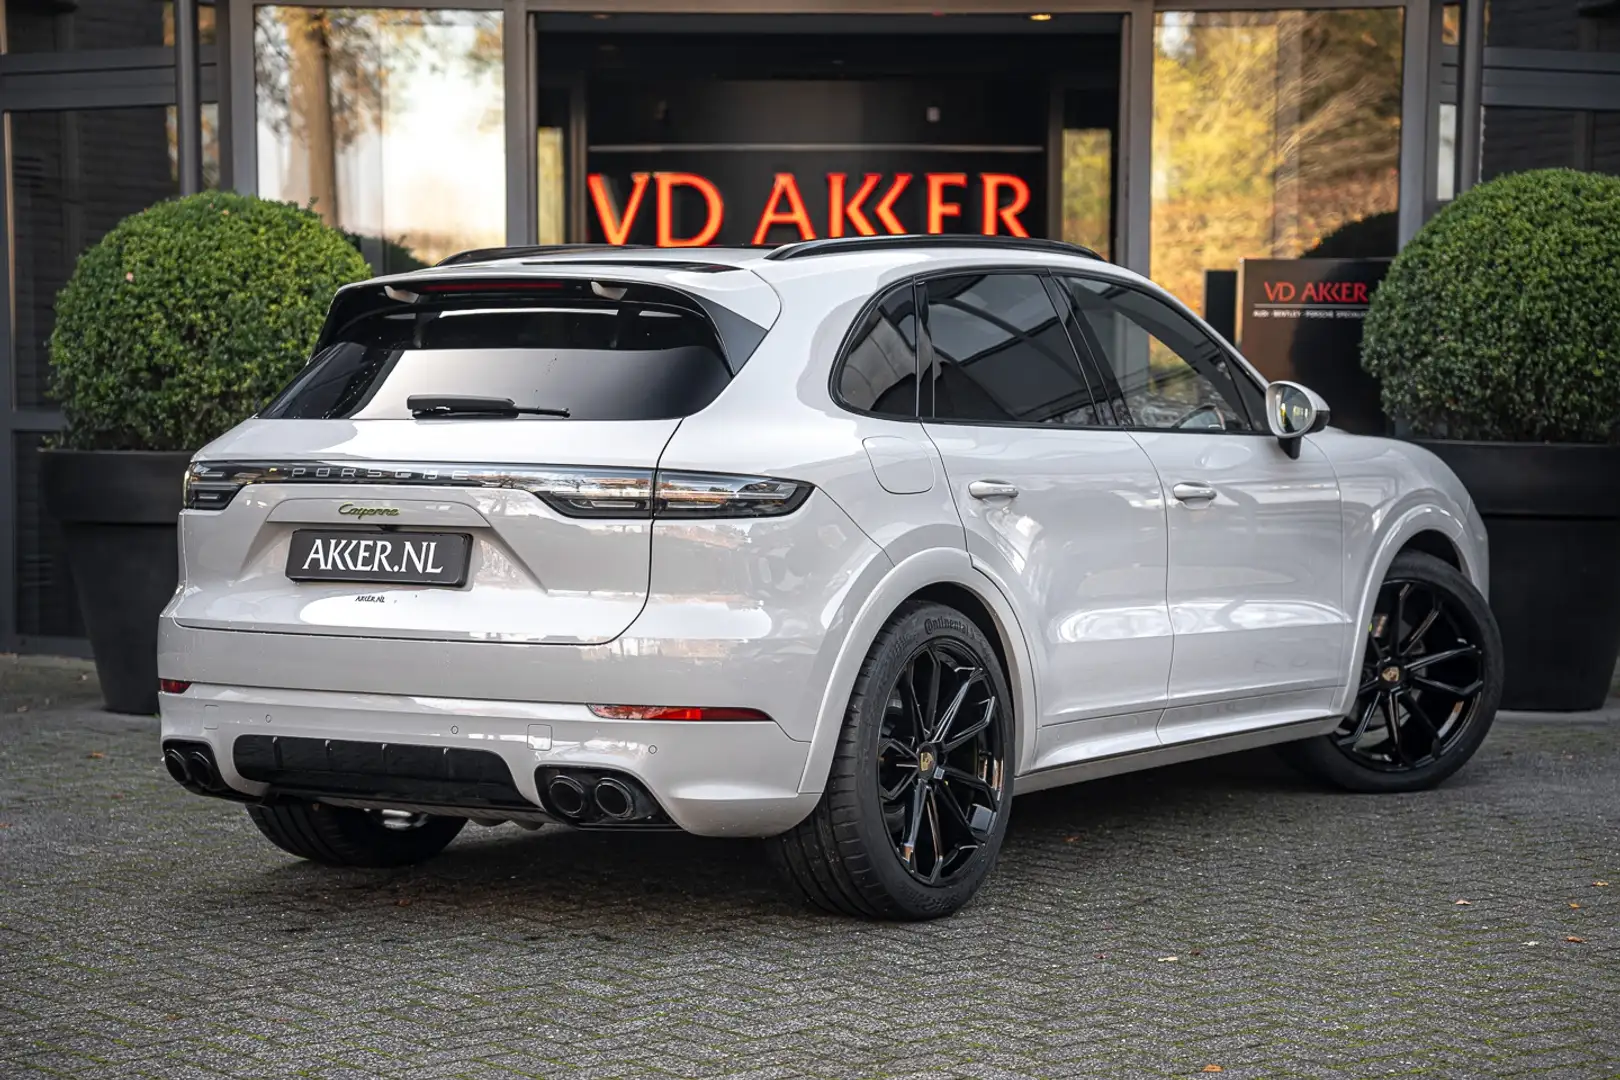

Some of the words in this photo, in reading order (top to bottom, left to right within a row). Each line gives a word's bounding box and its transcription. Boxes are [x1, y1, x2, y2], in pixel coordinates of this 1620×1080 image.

[587, 172, 724, 247] VD
[1263, 281, 1296, 303] VD
[1300, 281, 1369, 303] AKKER
[291, 467, 469, 481] PORSCHE
[338, 502, 400, 520] Cayenne
[302, 538, 444, 574] AKKER.NL
[924, 616, 969, 636] Continental
